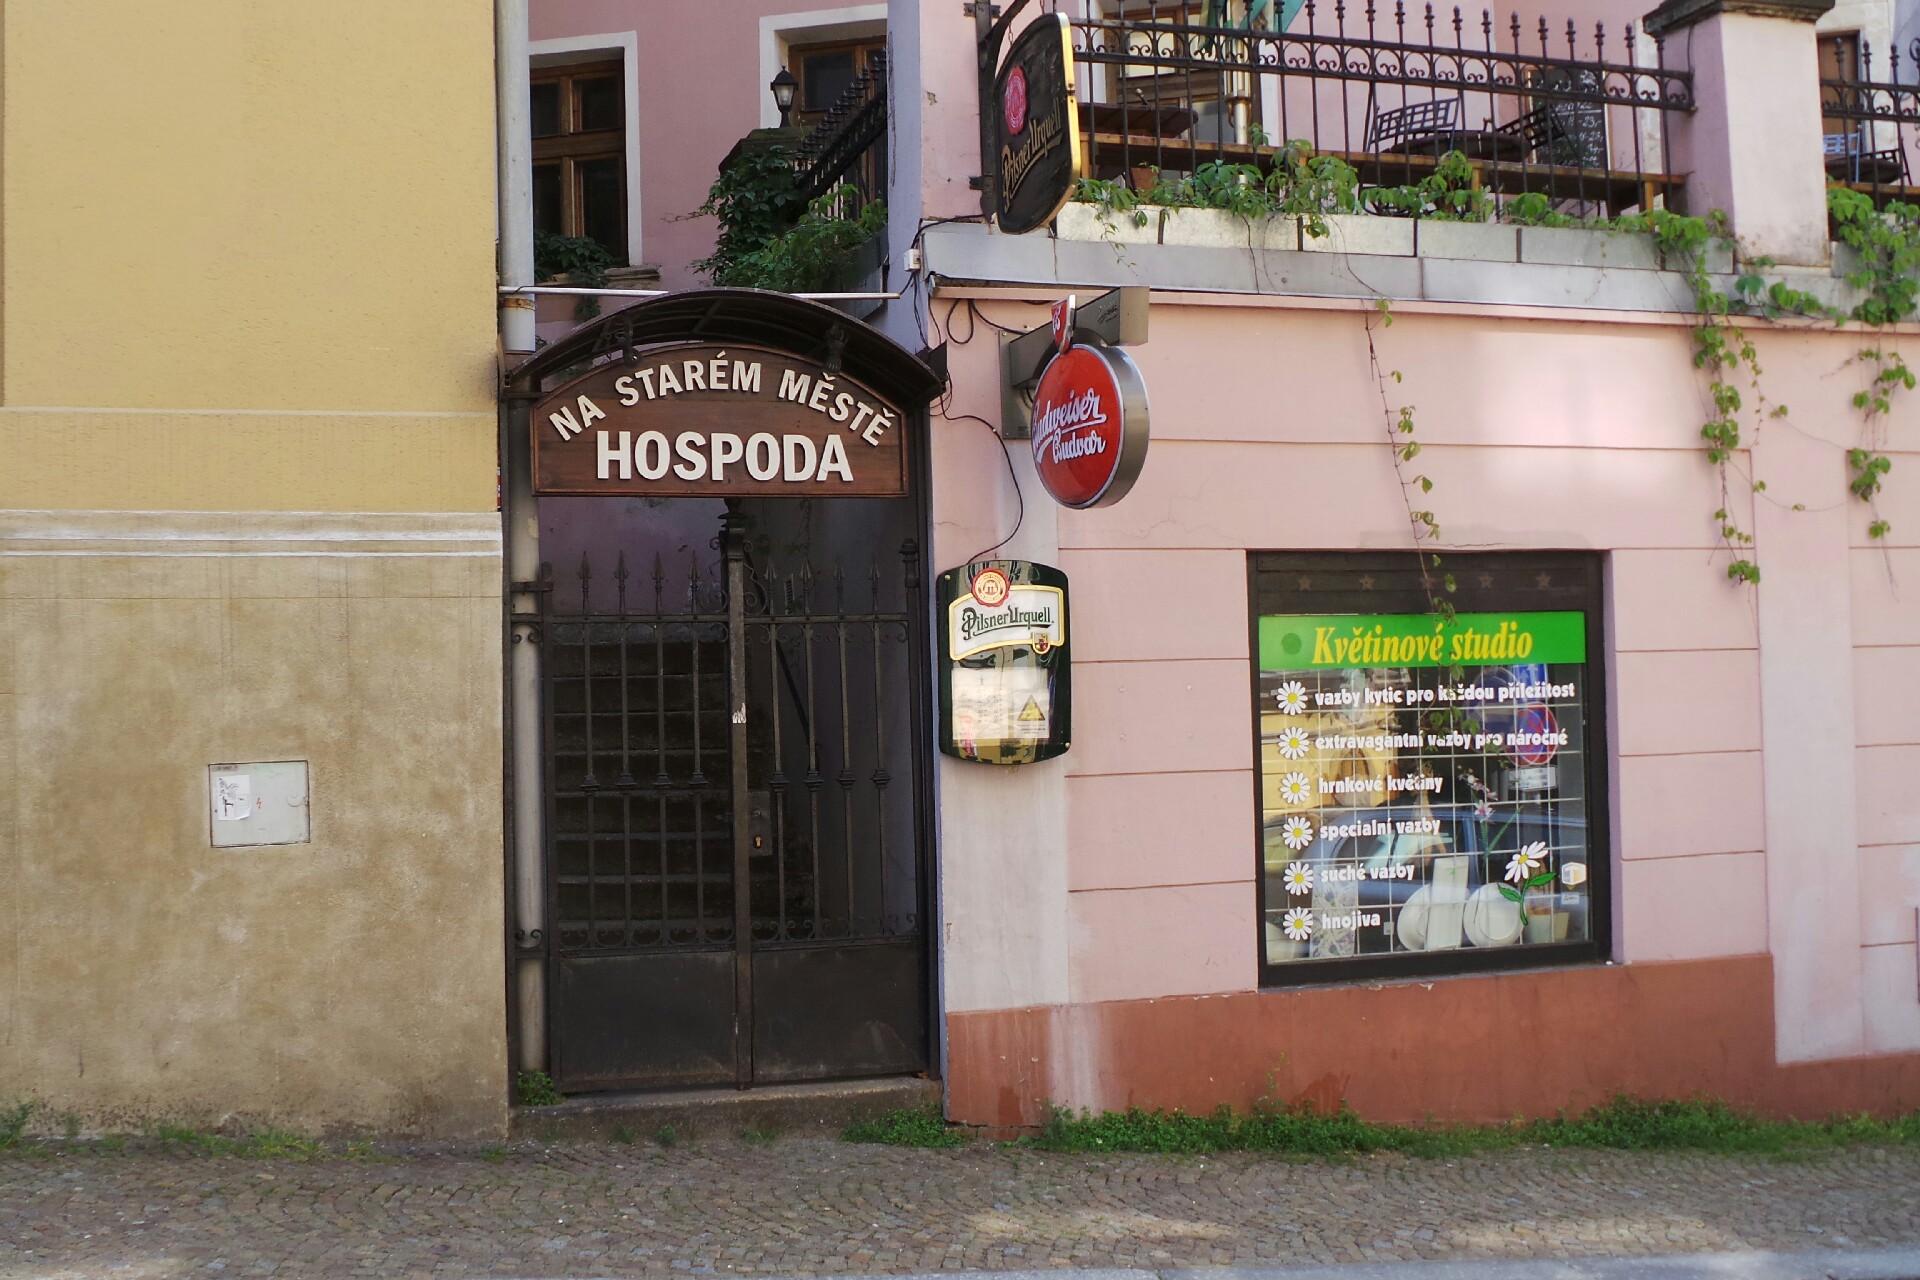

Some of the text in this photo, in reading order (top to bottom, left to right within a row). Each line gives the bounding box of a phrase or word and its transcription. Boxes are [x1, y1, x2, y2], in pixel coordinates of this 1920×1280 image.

[1002, 135, 1031, 213] Pilsner
[1028, 97, 1062, 158] Urquell
[549, 351, 896, 447] NA STARÉM MĚSTĚ
[597, 430, 854, 482] HOSPODA
[1052, 427, 1106, 464] Budvar
[961, 606, 1009, 641] Pilsner
[1312, 621, 1533, 664] Květinové studio
[1314, 688, 1361, 708] vazby
[1364, 686, 1403, 706] kytic
[1406, 687, 1434, 705] pro
[1498, 681, 1576, 703] příležitost
[1315, 730, 1423, 752] extravagantní
[1427, 730, 1471, 750] vazby
[1506, 728, 1568, 746] náročné
[1318, 774, 1382, 794] hrnkové
[1319, 817, 1441, 841] specialní vazby
[1321, 862, 1415, 882] suché vazby
[1321, 910, 1381, 931] hnojiva
